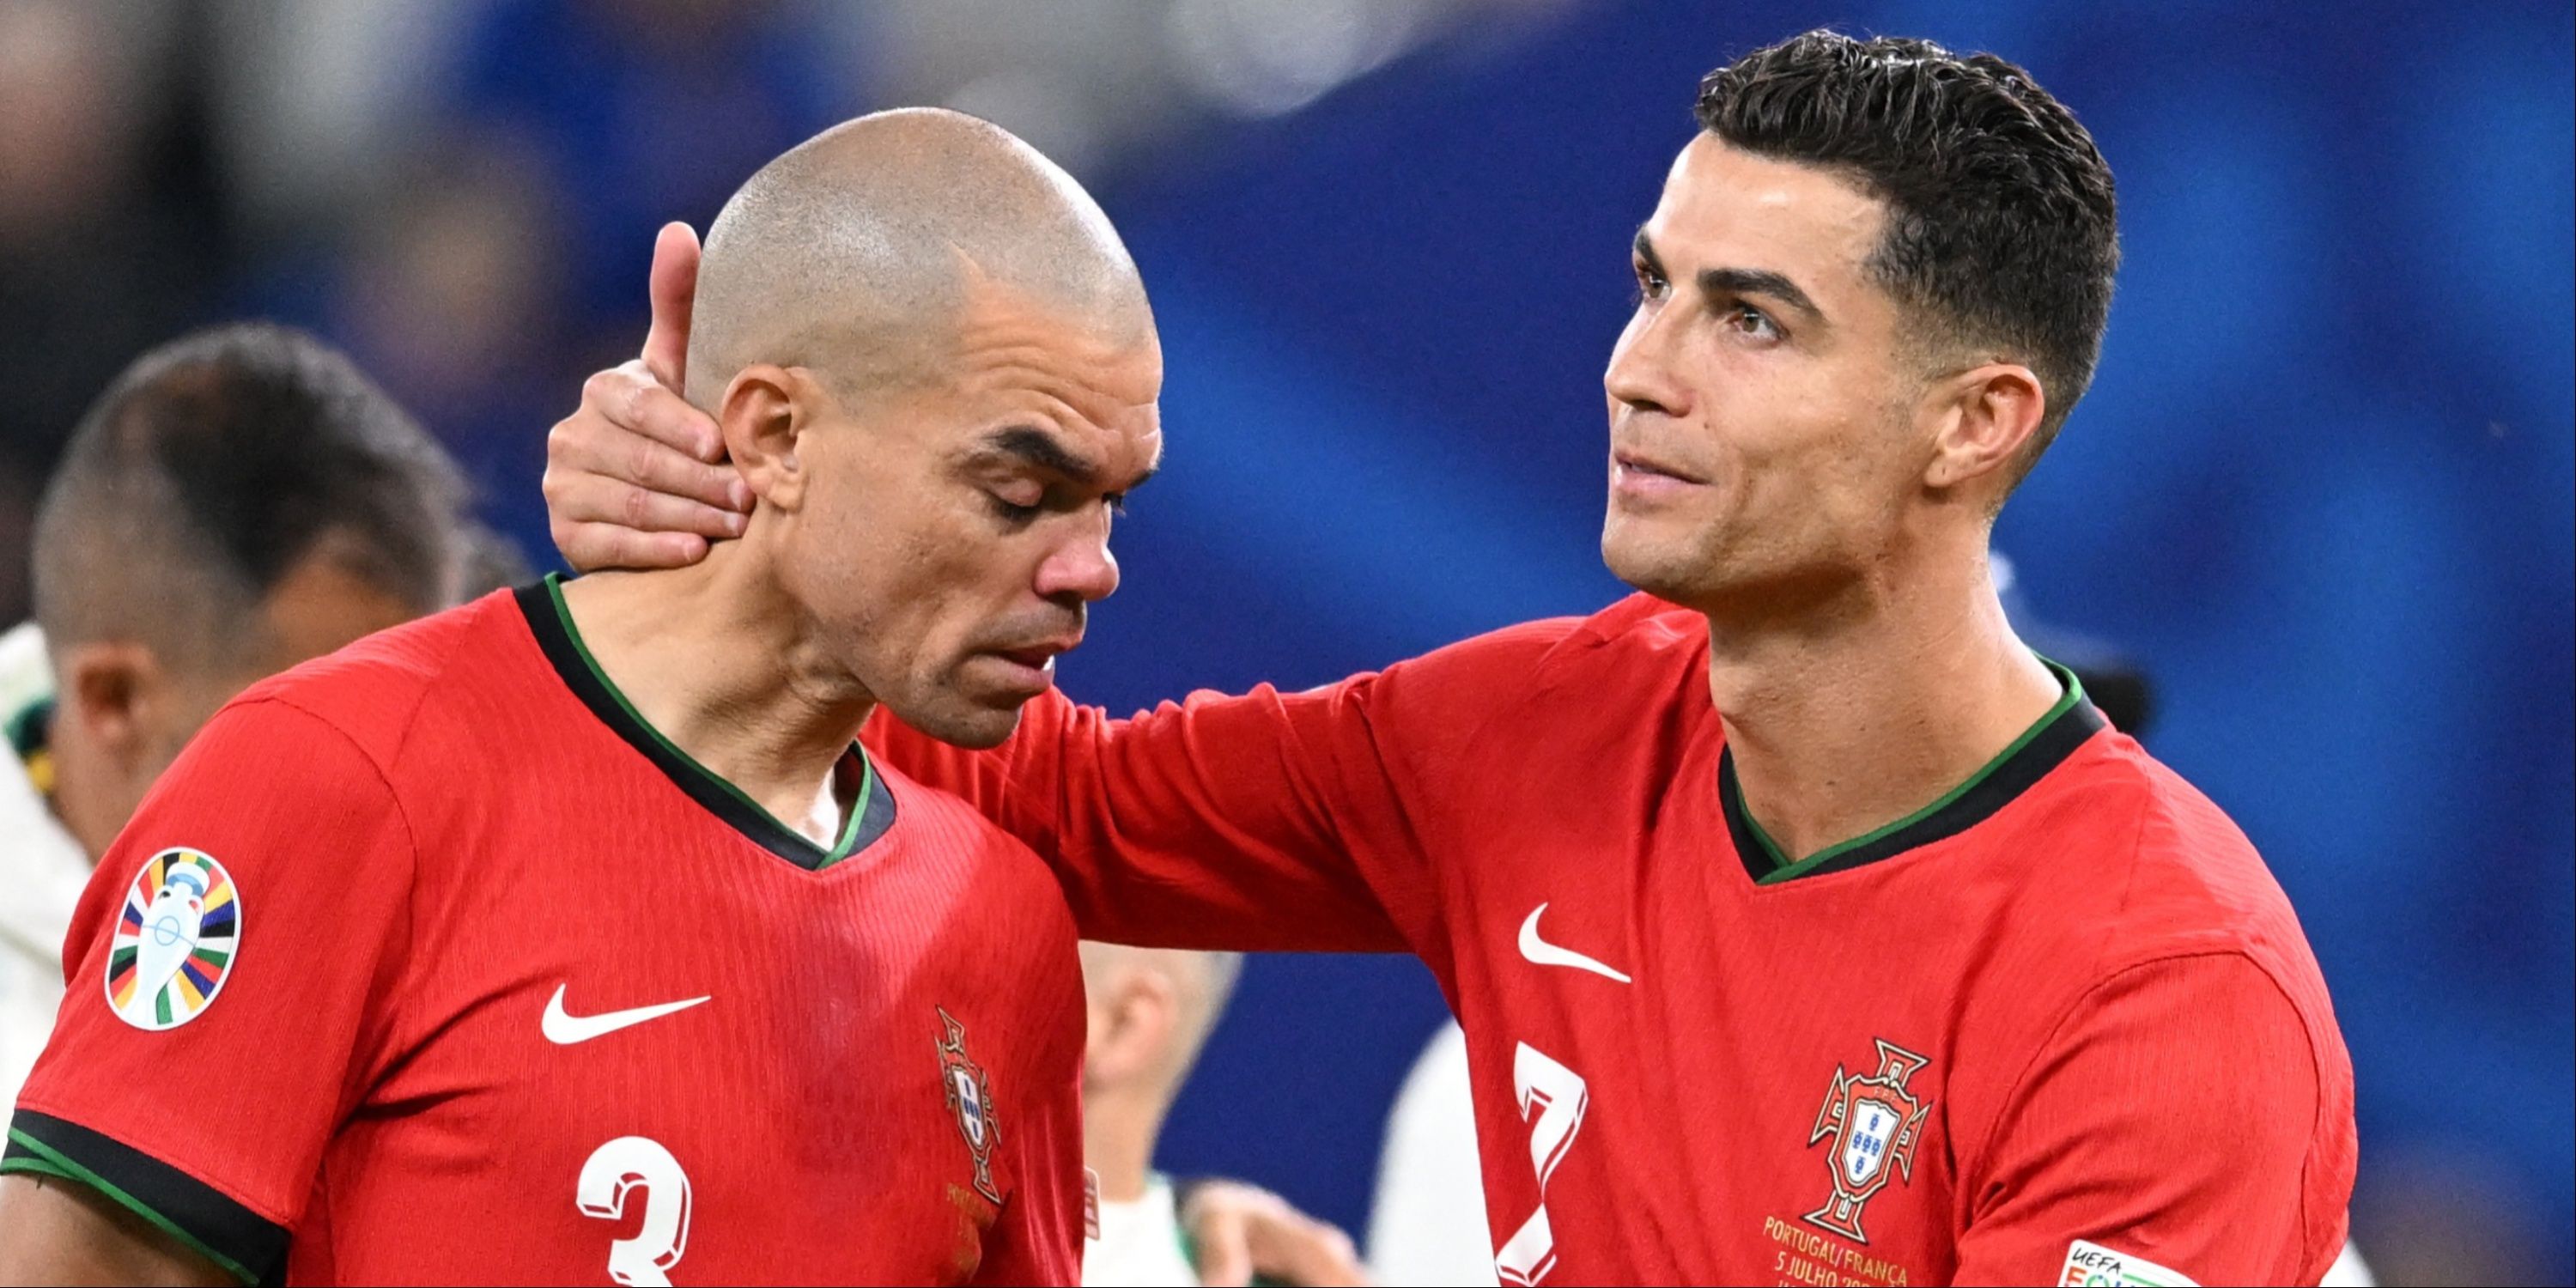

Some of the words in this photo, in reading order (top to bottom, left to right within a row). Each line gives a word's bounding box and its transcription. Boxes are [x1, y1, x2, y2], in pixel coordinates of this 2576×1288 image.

[1495, 1040, 1589, 1286] 7
[576, 1136, 692, 1286] 3
[1775, 1251, 1786, 1271] 5
[1787, 1256, 1838, 1286] JULHO
[2072, 1248, 2122, 1274] UEFA
